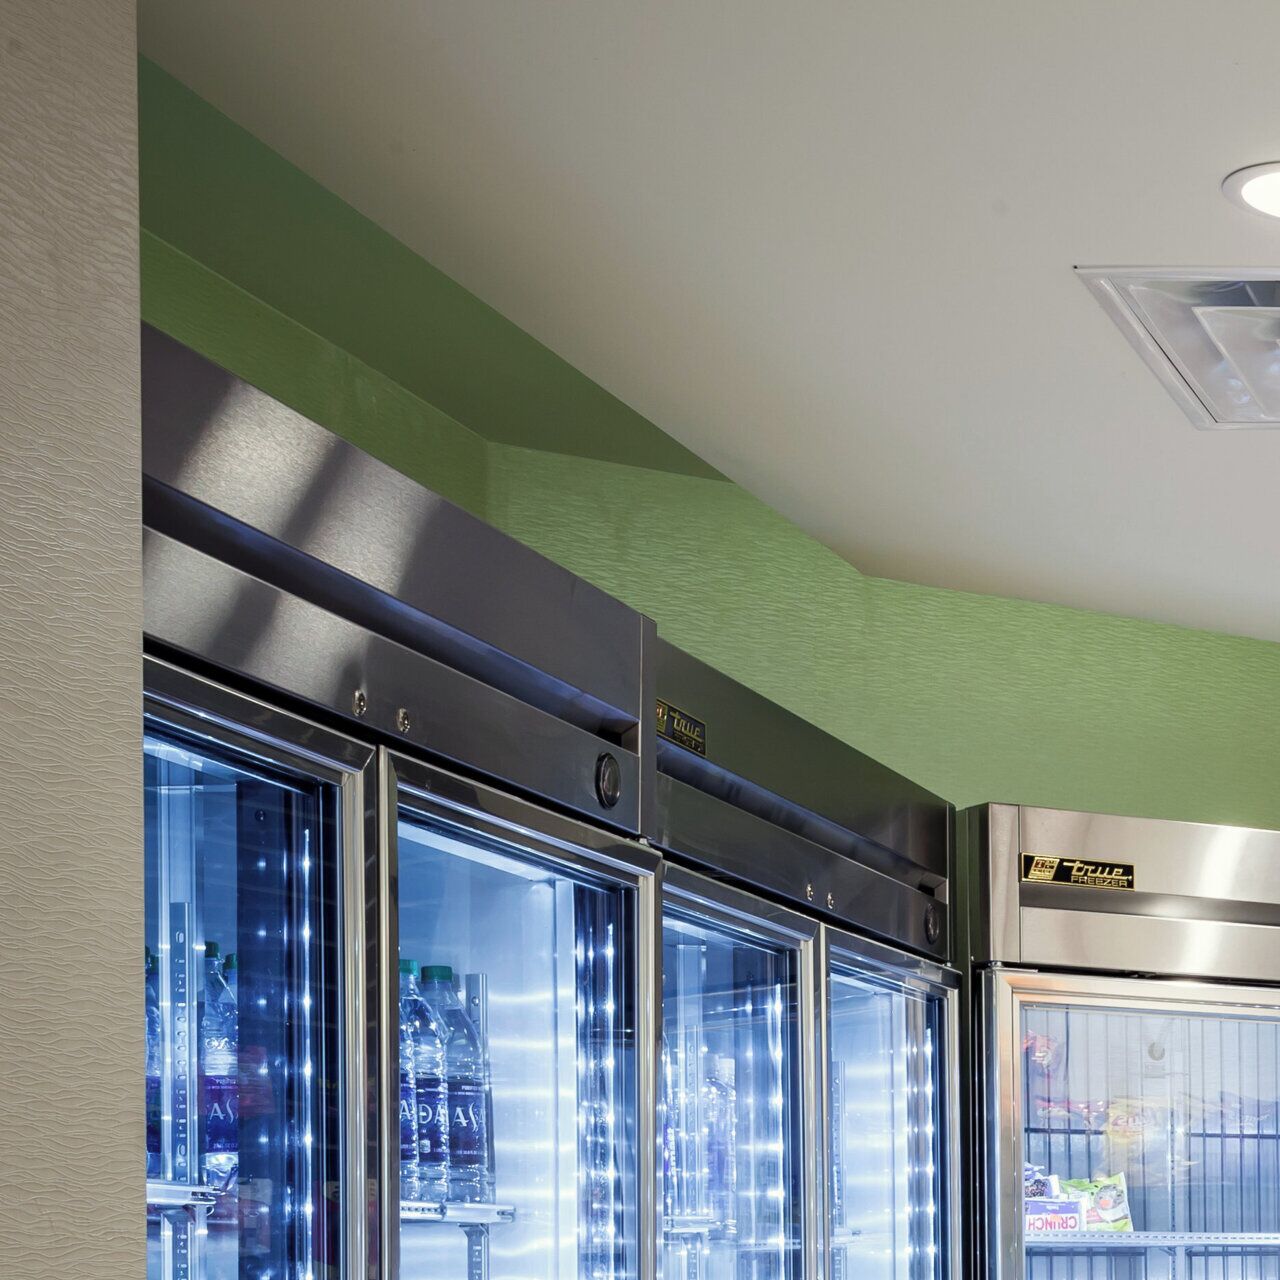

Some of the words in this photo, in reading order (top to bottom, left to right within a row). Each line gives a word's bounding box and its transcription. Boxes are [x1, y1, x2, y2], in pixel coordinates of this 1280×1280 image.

[1063, 861, 1132, 880] true
[1071, 876, 1128, 887] FREEZER
[1028, 1214, 1077, 1231] CRUNCH
